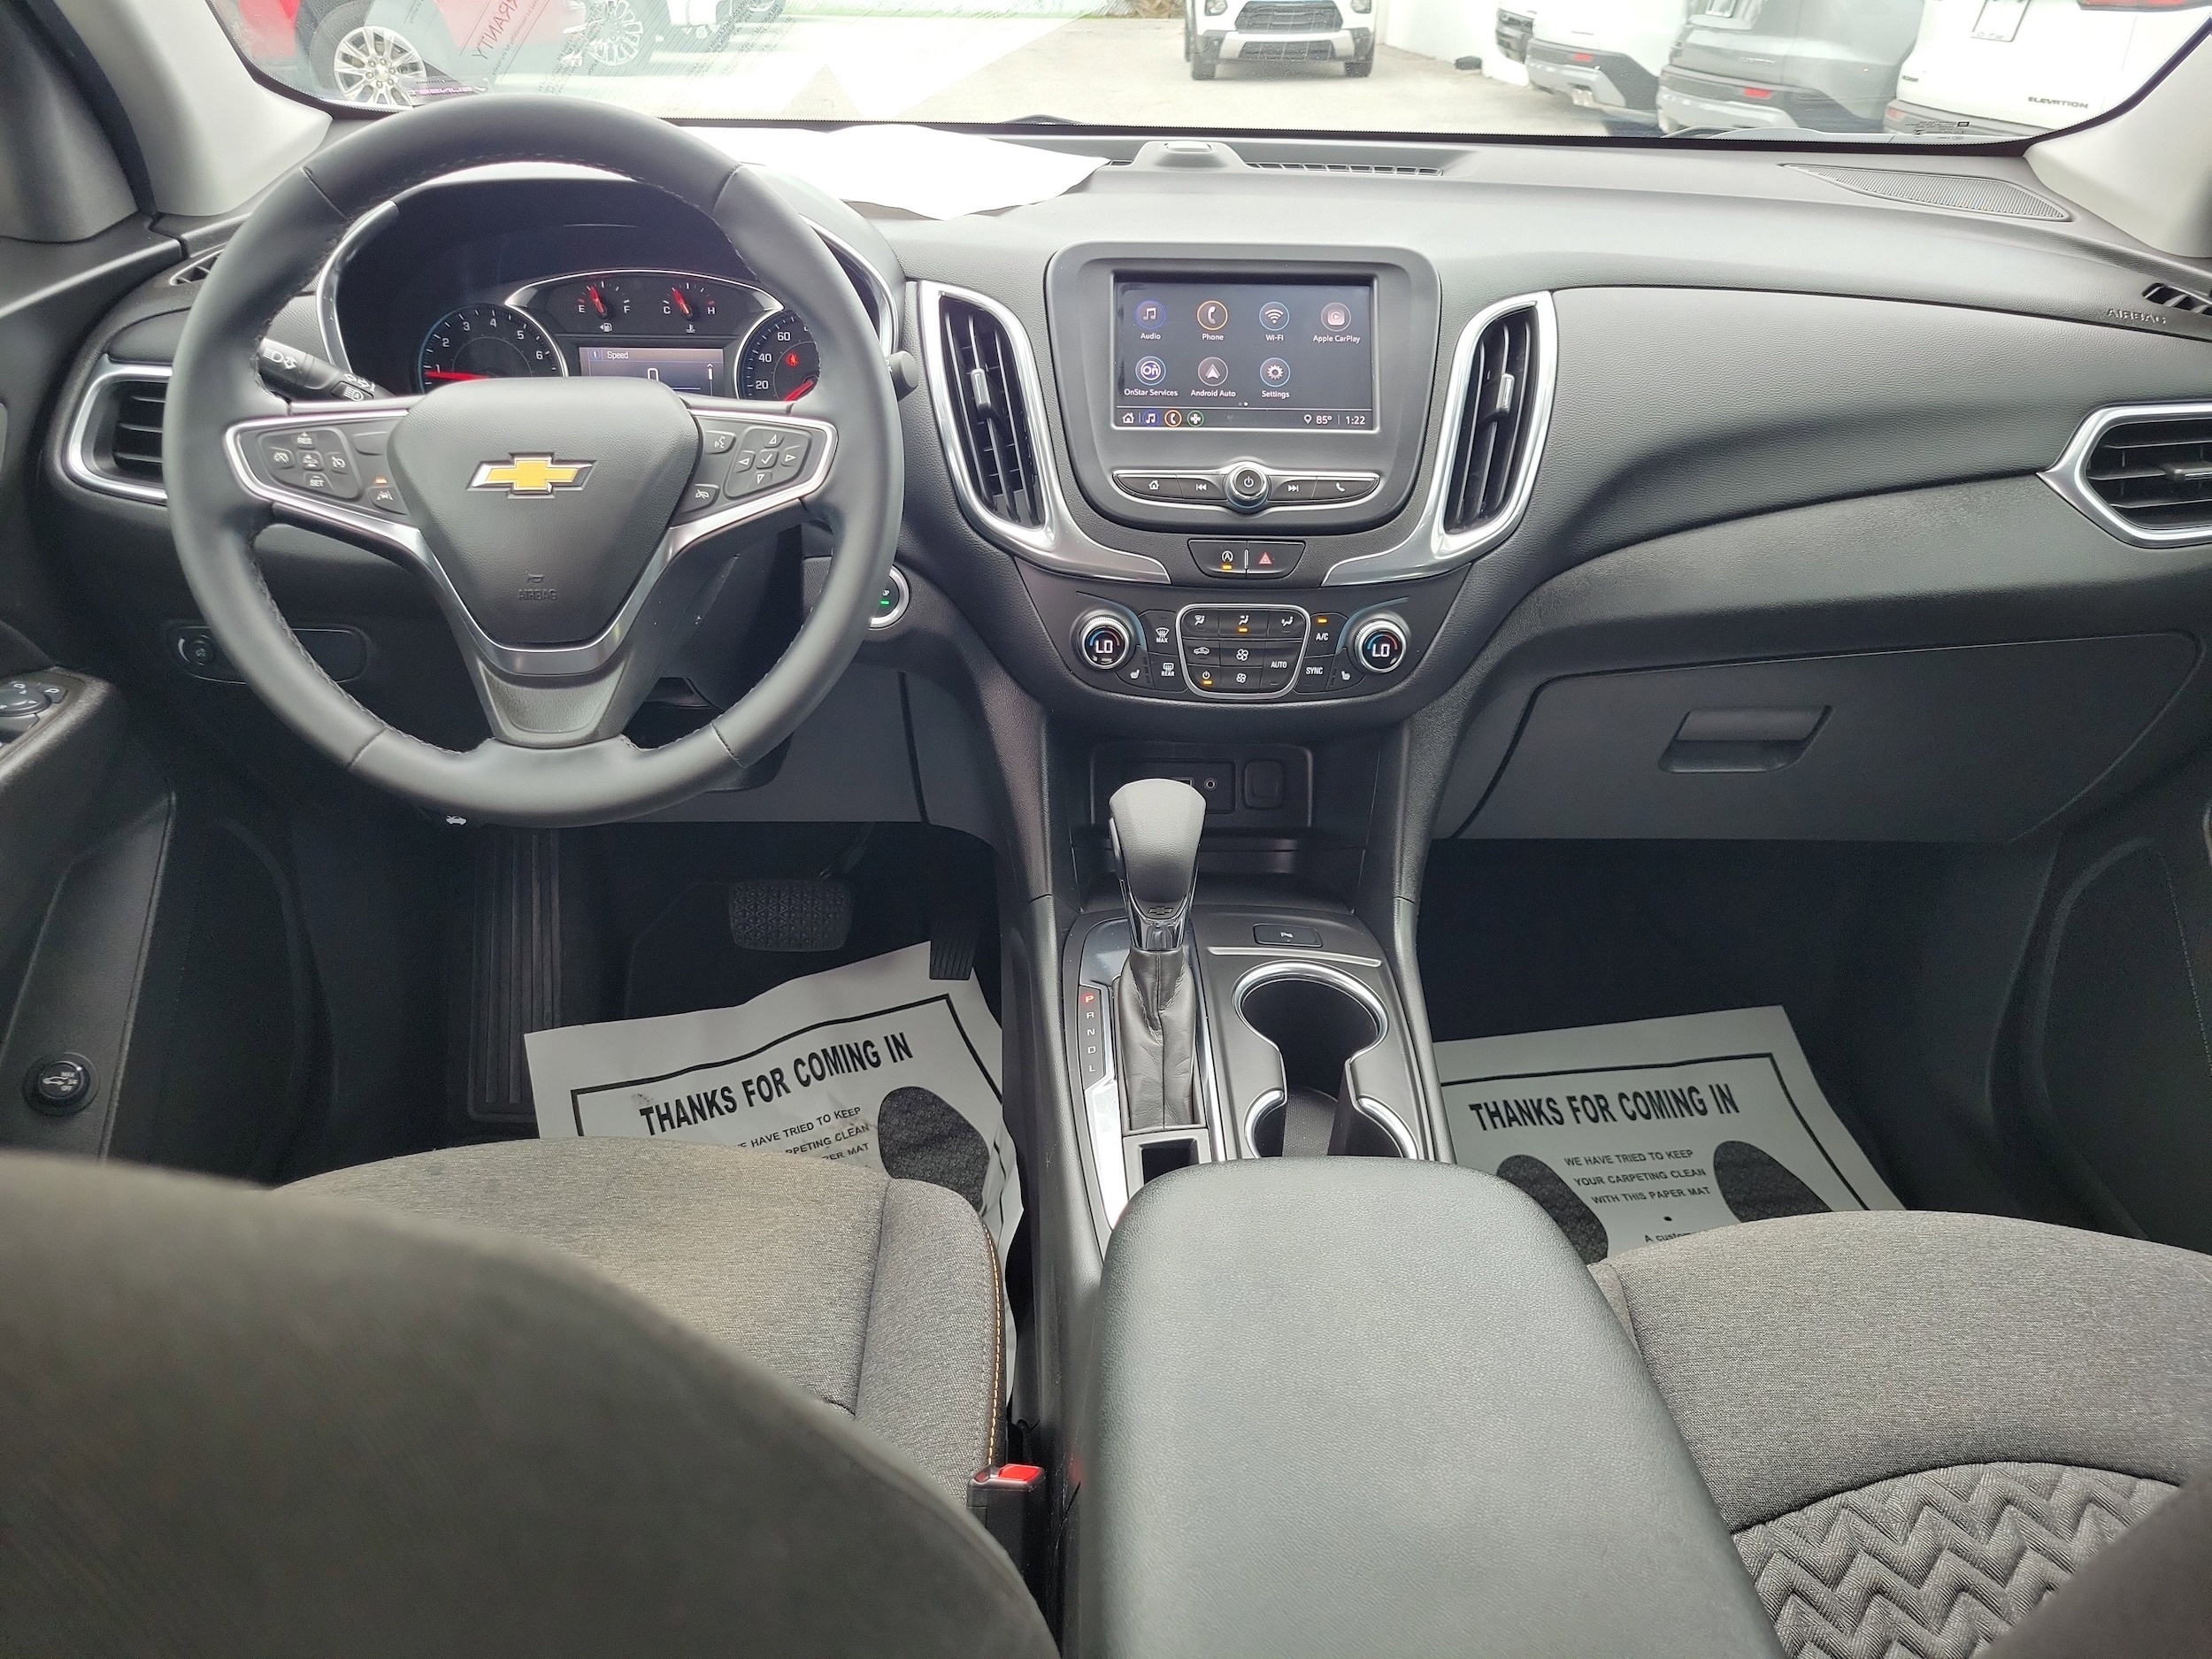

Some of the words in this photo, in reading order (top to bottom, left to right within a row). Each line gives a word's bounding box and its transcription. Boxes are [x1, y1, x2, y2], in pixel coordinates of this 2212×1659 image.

[2028, 96, 2088, 109] ELEVATION
[707, 306, 716, 315] H
[2108, 308, 2166, 325] AIRBAG
[463, 320, 471, 331] 3
[489, 318, 497, 328] 4
[517, 330, 525, 341] 5
[777, 331, 791, 342] 60
[1202, 333, 1224, 342] Phone
[1313, 334, 1333, 343] Apple
[1334, 334, 1360, 343] CarPlay
[442, 337, 449, 348] 2
[535, 350, 542, 360] 6
[606, 350, 629, 360] Speed
[758, 353, 772, 364] 40
[755, 380, 769, 390] 20
[1262, 390, 1290, 399] Settings
[1345, 415, 1365, 425] 1:22
[518, 588, 557, 601] AIRBAG
[1316, 632, 1329, 641] A/C
[1095, 640, 1113, 654] LO
[1371, 643, 1389, 657] LO
[1271, 660, 1287, 669] AUTO
[1306, 666, 1324, 675] SYNC
[1084, 995, 1094, 1003] P
[640, 1086, 737, 1136] THANKS
[742, 1066, 790, 1108] FOR
[793, 1039, 882, 1087] COMING
[885, 1032, 913, 1063] IN
[1469, 1096, 1565, 1132] THANKS
[1565, 1092, 1617, 1125] FOR
[1618, 1085, 1709, 1121] COMING
[1709, 1082, 1740, 1114] IN
[750, 1132, 780, 1148] HAVE
[782, 1122, 814, 1138] TRIED
[816, 1114, 832, 1125] TO
[833, 1107, 861, 1119] KEEP
[834, 1122, 870, 1141] CLEAN
[847, 1143, 870, 1156] MAT
[1563, 1157, 1583, 1166] WE
[1584, 1155, 1613, 1165] HAVE
[1614, 1153, 1647, 1164] TRIED
[1647, 1152, 1663, 1161] TO
[1665, 1149, 1693, 1159] KEEP
[1573, 1176, 1605, 1187] YOUR
[1607, 1171, 1668, 1184] CARPETING
[1670, 1168, 1707, 1179] CLEAN
[1591, 1194, 1620, 1204] WITH
[1620, 1192, 1647, 1202] THIS
[1650, 1189, 1686, 1200] PAPER
[1686, 1187, 1710, 1196] MAT
[1645, 1234, 1654, 1243] A
